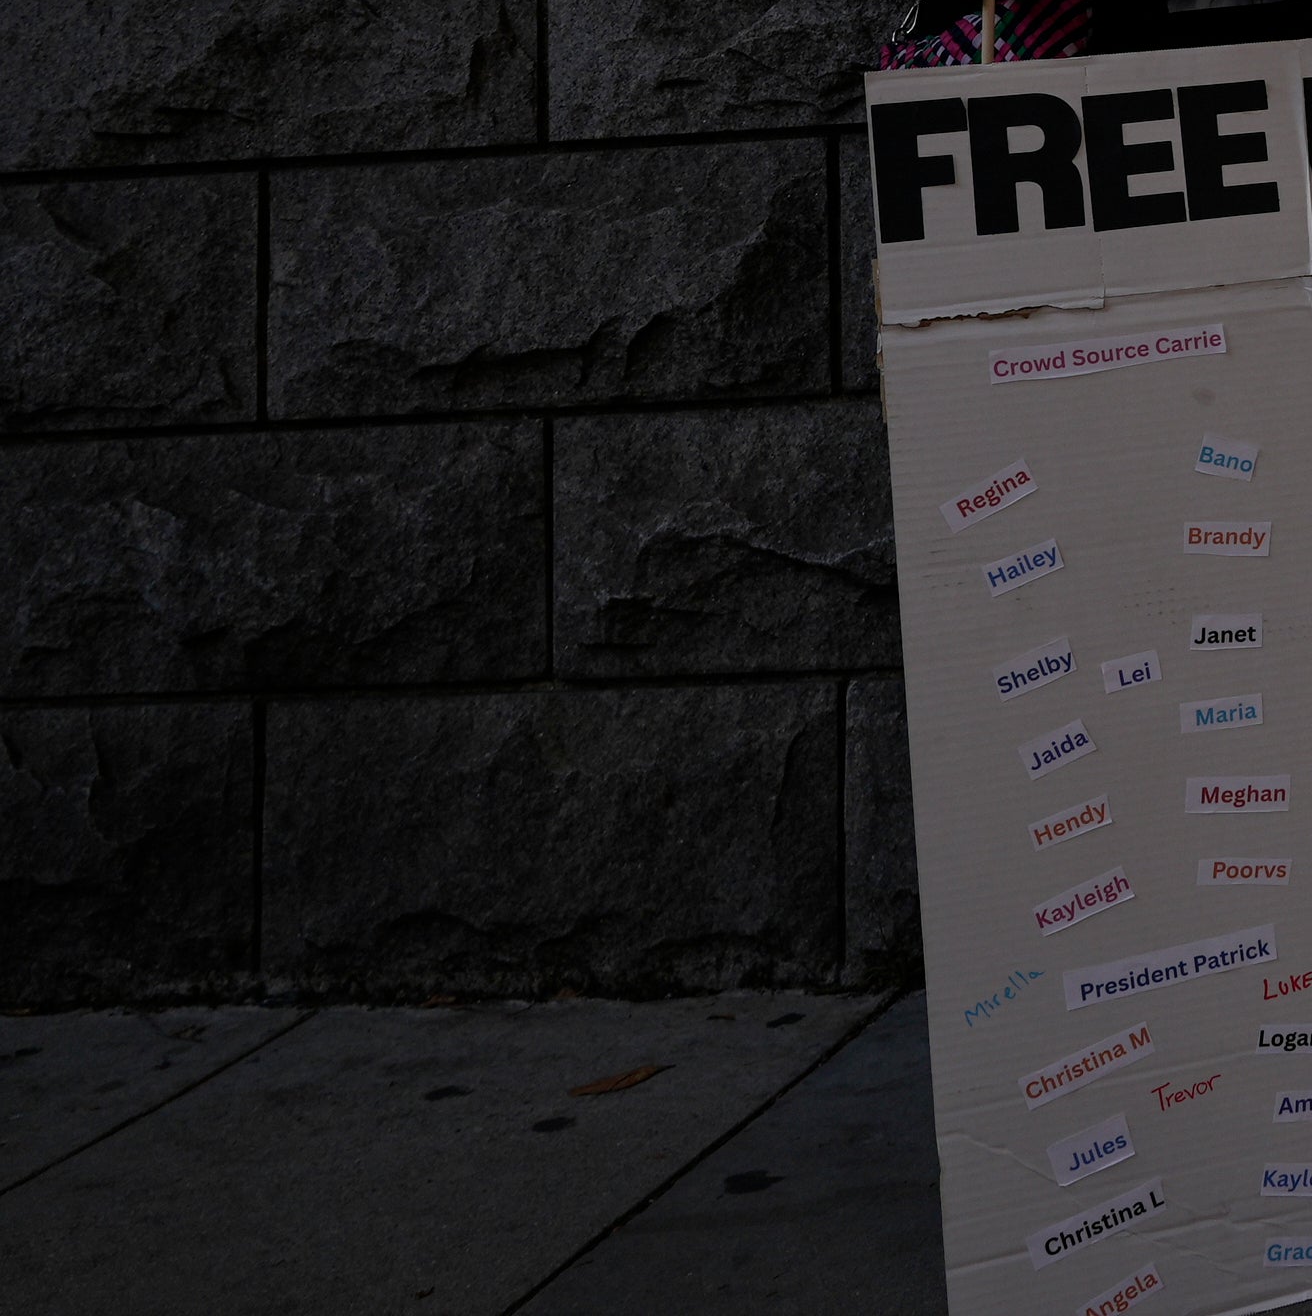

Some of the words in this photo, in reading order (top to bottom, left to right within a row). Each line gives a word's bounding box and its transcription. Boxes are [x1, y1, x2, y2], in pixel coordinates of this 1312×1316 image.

[870, 80, 1280, 244] FREE
[993, 350, 1067, 378] Crowd
[1072, 338, 1150, 367] Source
[1155, 330, 1223, 356] Carrie
[1198, 446, 1254, 474] Bano
[956, 468, 1031, 518] Regina
[1187, 527, 1267, 550] Brandy
[986, 546, 1060, 589] Hailey
[1194, 625, 1257, 645] Janet
[997, 650, 1075, 694] Shelby
[1118, 663, 1152, 687] Lei
[1195, 703, 1258, 726] Maria
[1030, 730, 1090, 771] Jaida
[1200, 785, 1287, 808] Meghan
[1033, 800, 1108, 846] Hendy
[1212, 861, 1287, 880] Poorvs
[1035, 874, 1131, 930] Kayleigh
[1079, 960, 1189, 1001] President
[1193, 939, 1271, 974] Patrick
[1025, 1044, 1127, 1100] Christina
[1129, 1027, 1152, 1050] M
[1152, 1074, 1222, 1111] Trevor
[1068, 1132, 1128, 1172] Jules
[1044, 1201, 1148, 1257] Christina
[1150, 1189, 1165, 1209] L
